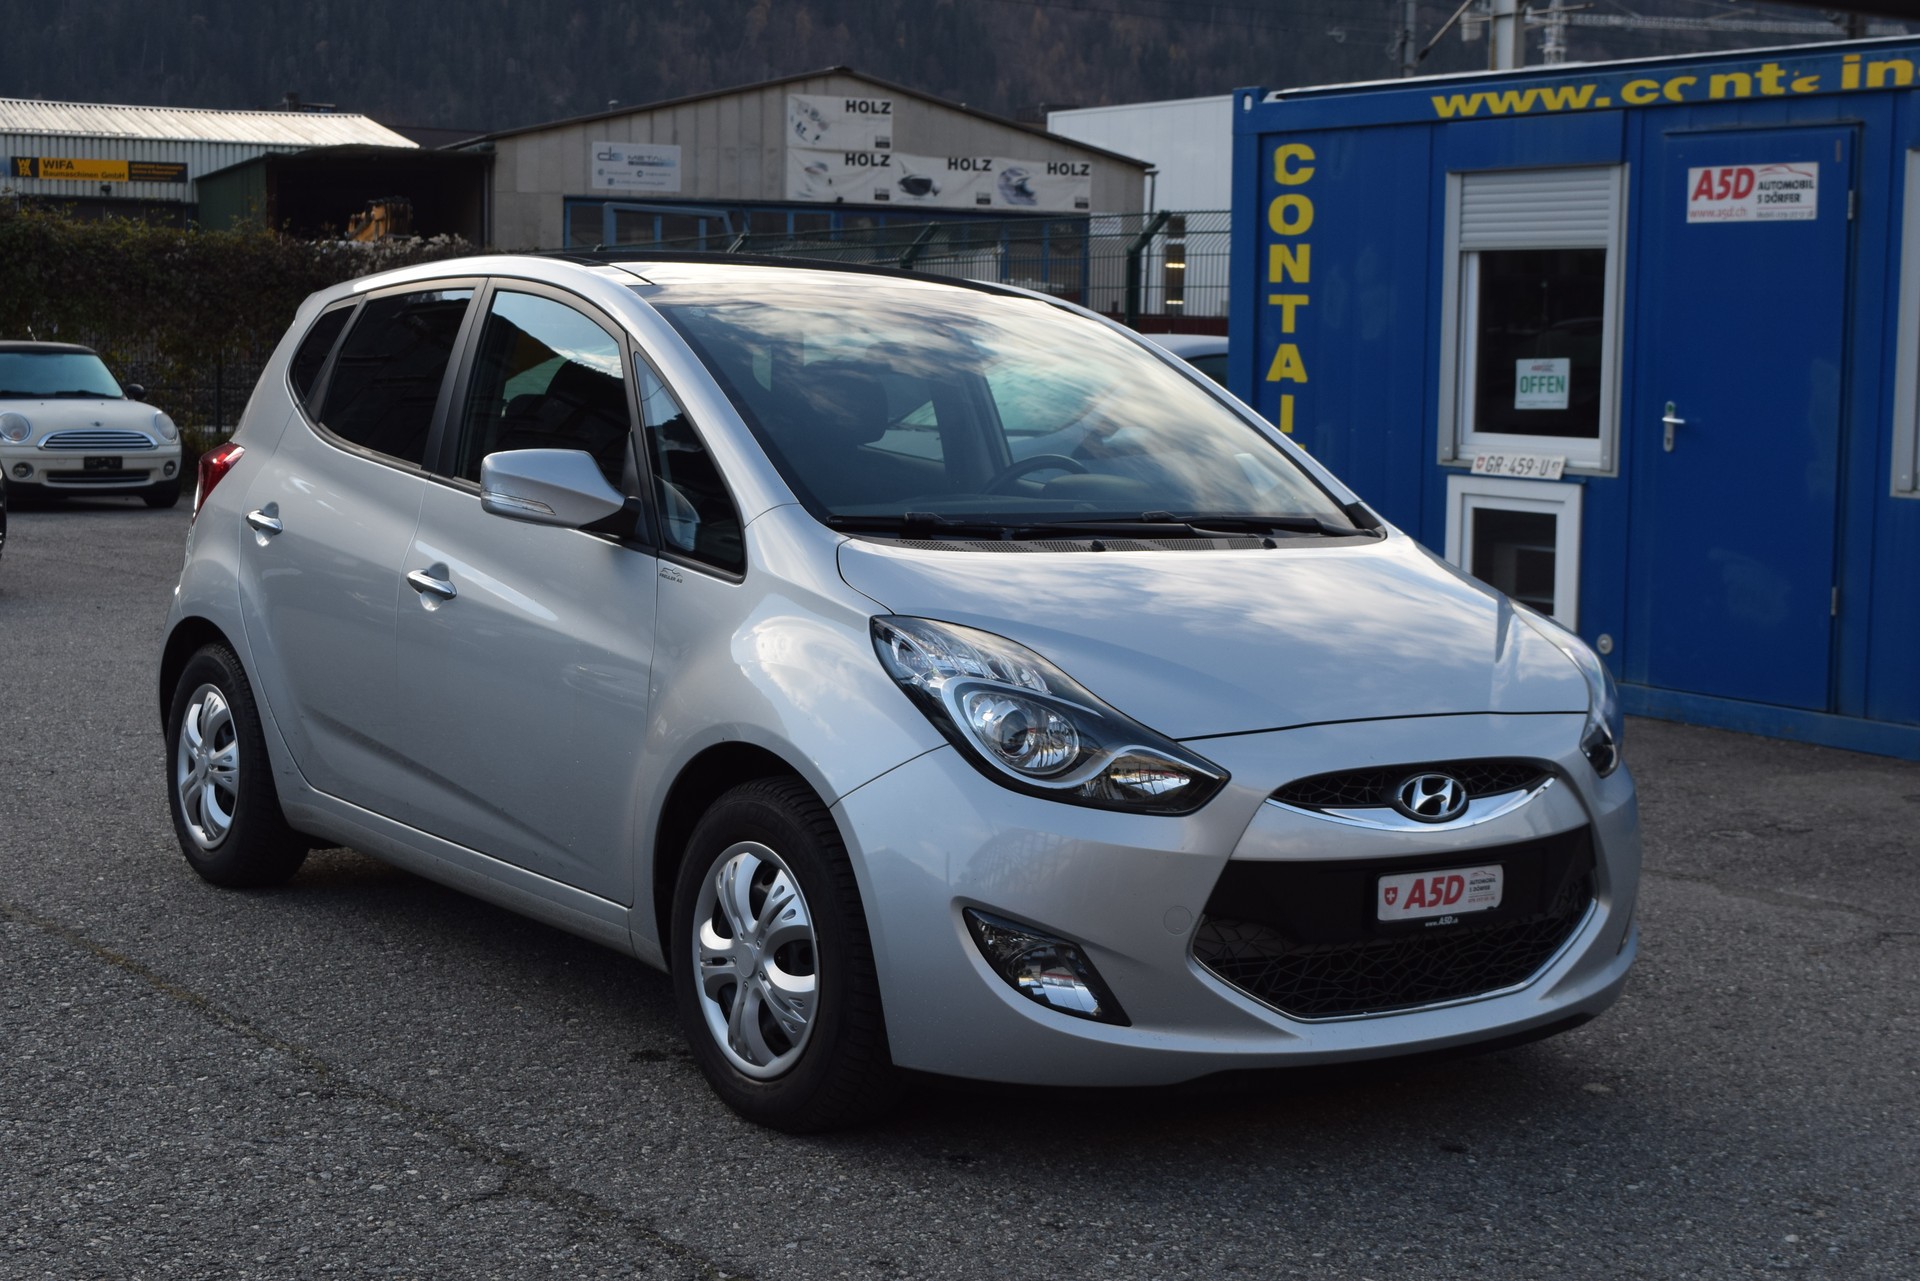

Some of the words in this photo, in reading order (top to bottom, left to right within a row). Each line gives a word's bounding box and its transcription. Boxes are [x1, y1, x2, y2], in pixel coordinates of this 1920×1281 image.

[845, 100, 892, 115] HOLZ
[43, 160, 74, 170] WIFA
[844, 153, 891, 167] HOLZ
[947, 157, 992, 171] HOLZ
[43, 171, 99, 179] Baumaschinen
[102, 172, 125, 180] GmbH
[1047, 163, 1090, 176] HOLZ
[1757, 180, 1815, 191] AUTOMOBIL
[1265, 143, 1316, 451] CONTAI
[1520, 375, 1565, 394] OFFEN
[1403, 875, 1465, 909] A5D
